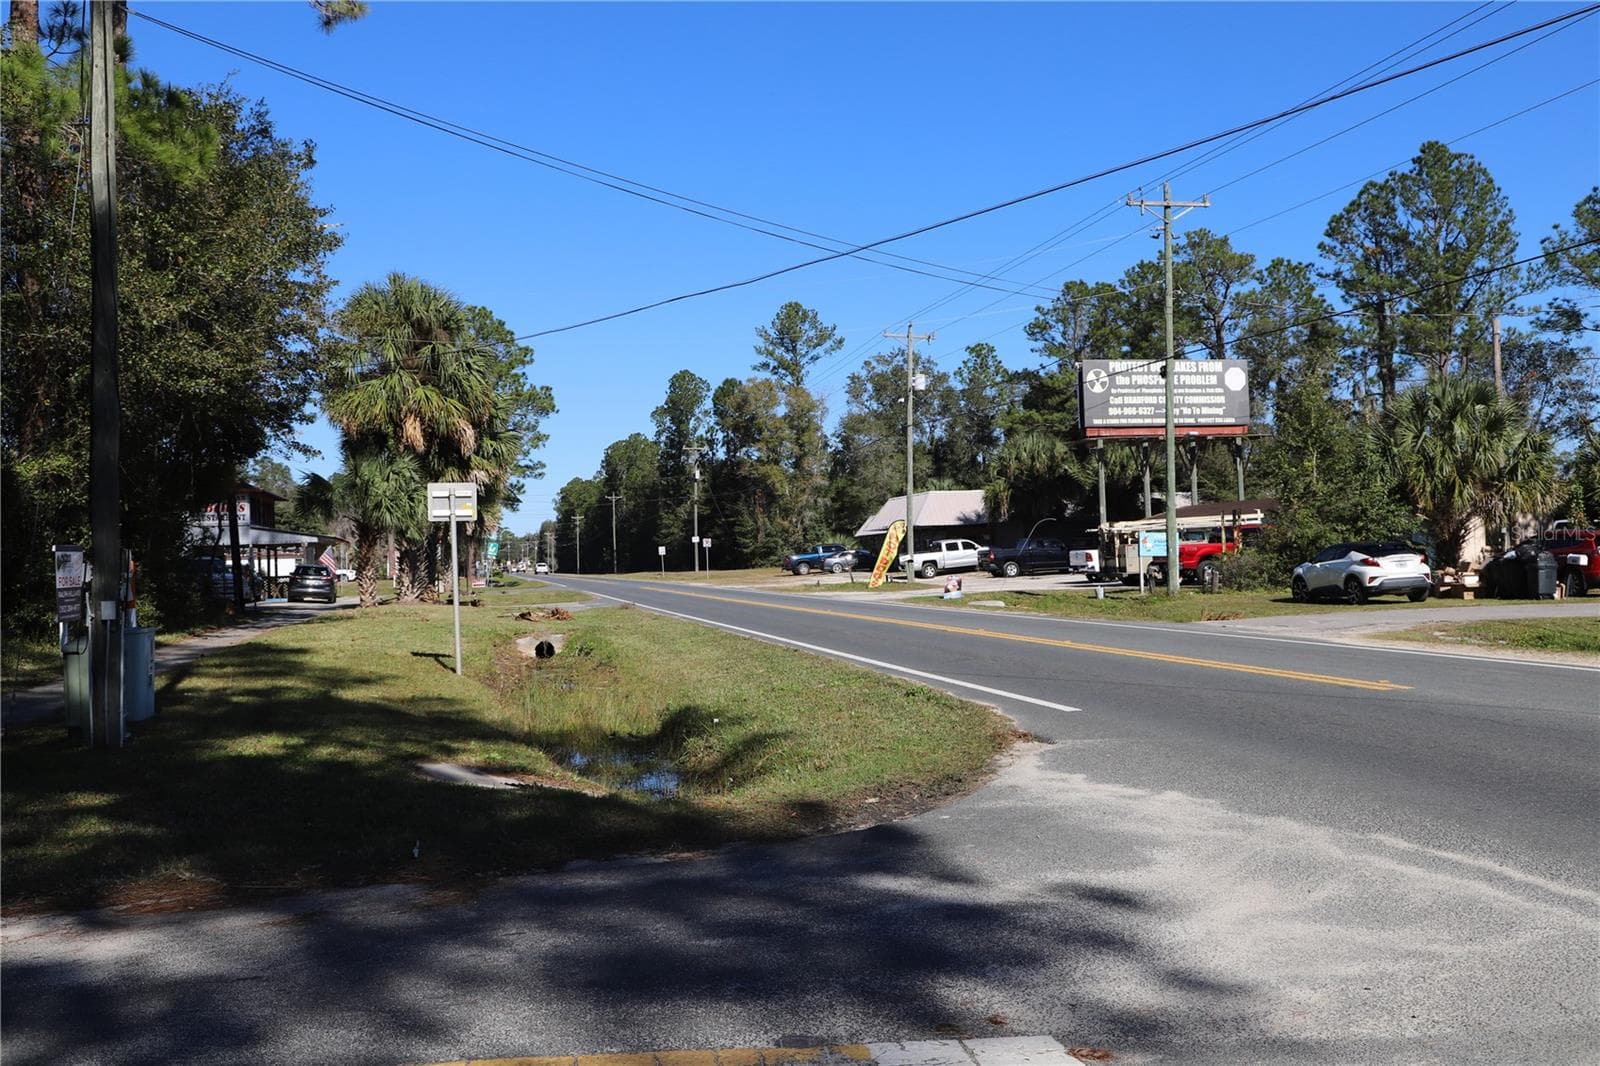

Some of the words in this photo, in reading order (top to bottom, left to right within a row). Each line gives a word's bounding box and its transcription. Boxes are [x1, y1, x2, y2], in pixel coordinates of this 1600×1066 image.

[1109, 361, 1148, 372] PROTECT
[1173, 361, 1197, 372] AKES
[1198, 361, 1223, 372] FROM
[1116, 375, 1130, 385] the
[1131, 374, 1179, 385] PHOSPHE
[1180, 374, 1217, 385] PROBLEM
[58, 576, 70, 587] FOR
[69, 575, 81, 587] SALE
